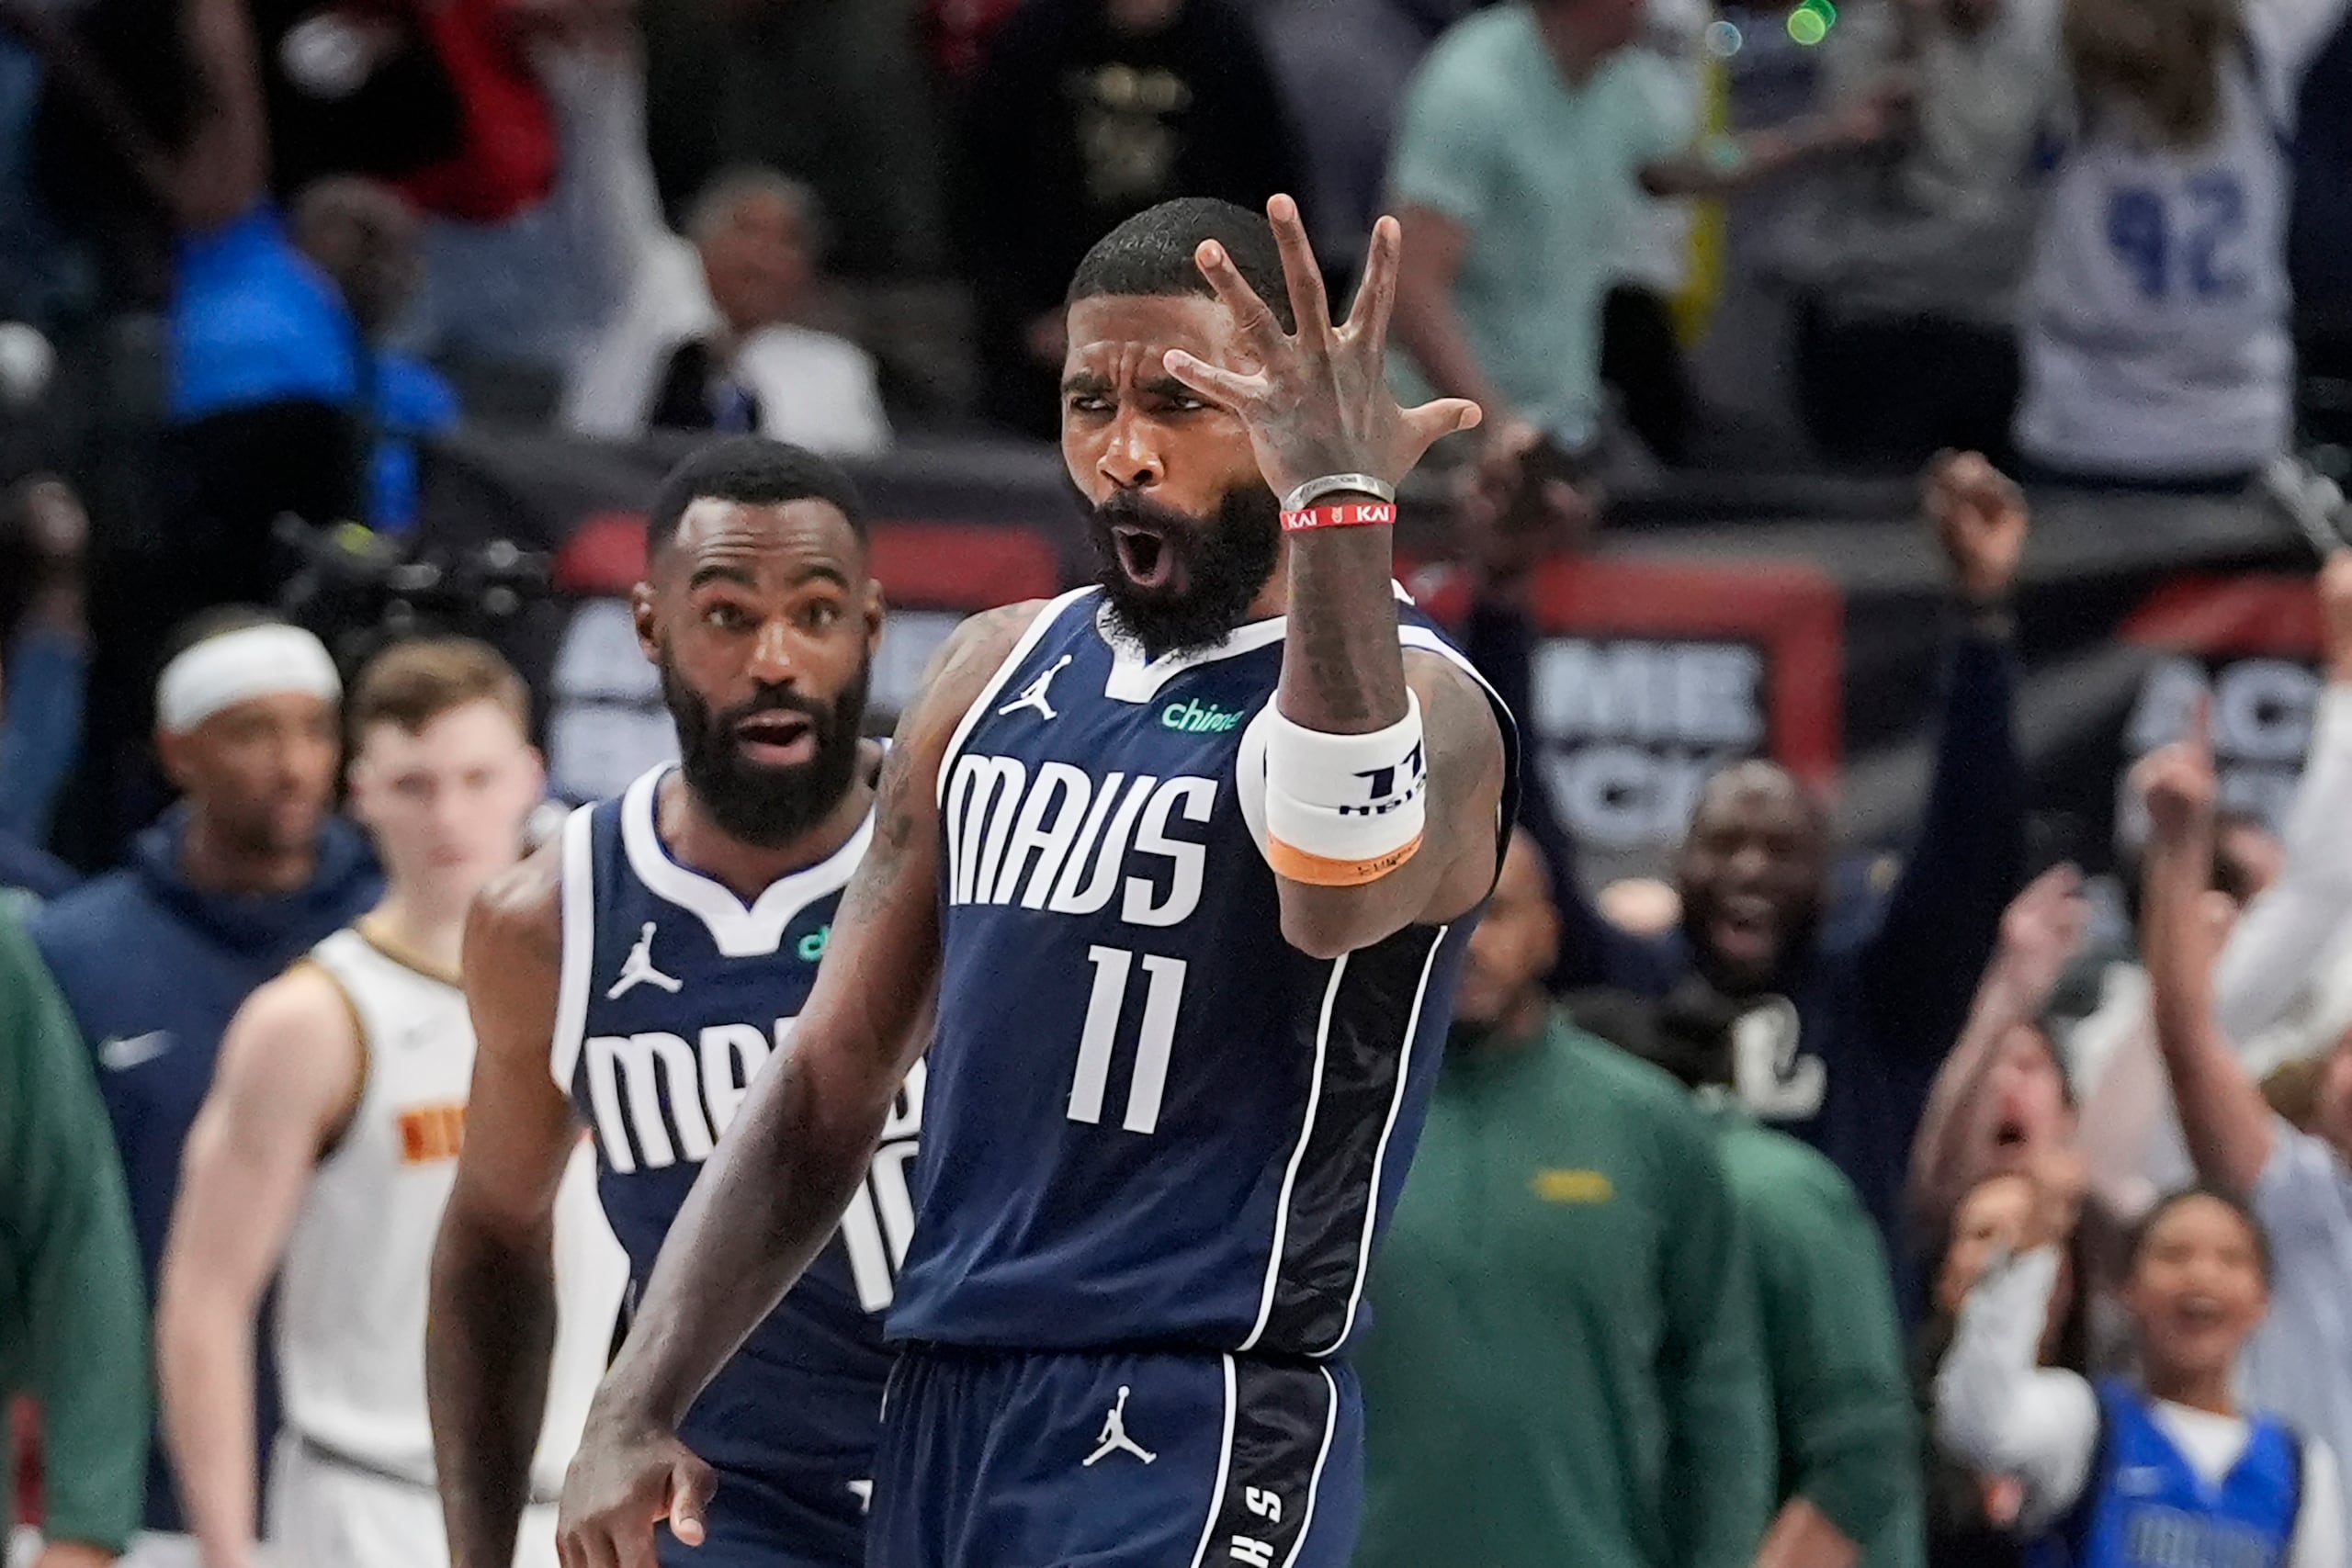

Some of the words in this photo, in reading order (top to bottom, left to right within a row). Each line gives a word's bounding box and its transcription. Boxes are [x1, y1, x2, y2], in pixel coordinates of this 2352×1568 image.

[1286, 511, 1317, 528] KAI
[1356, 505, 1389, 522] KAI
[1161, 698, 1245, 732] chime
[945, 753, 1219, 928] MAVS
[1066, 943, 1188, 1134] 11
